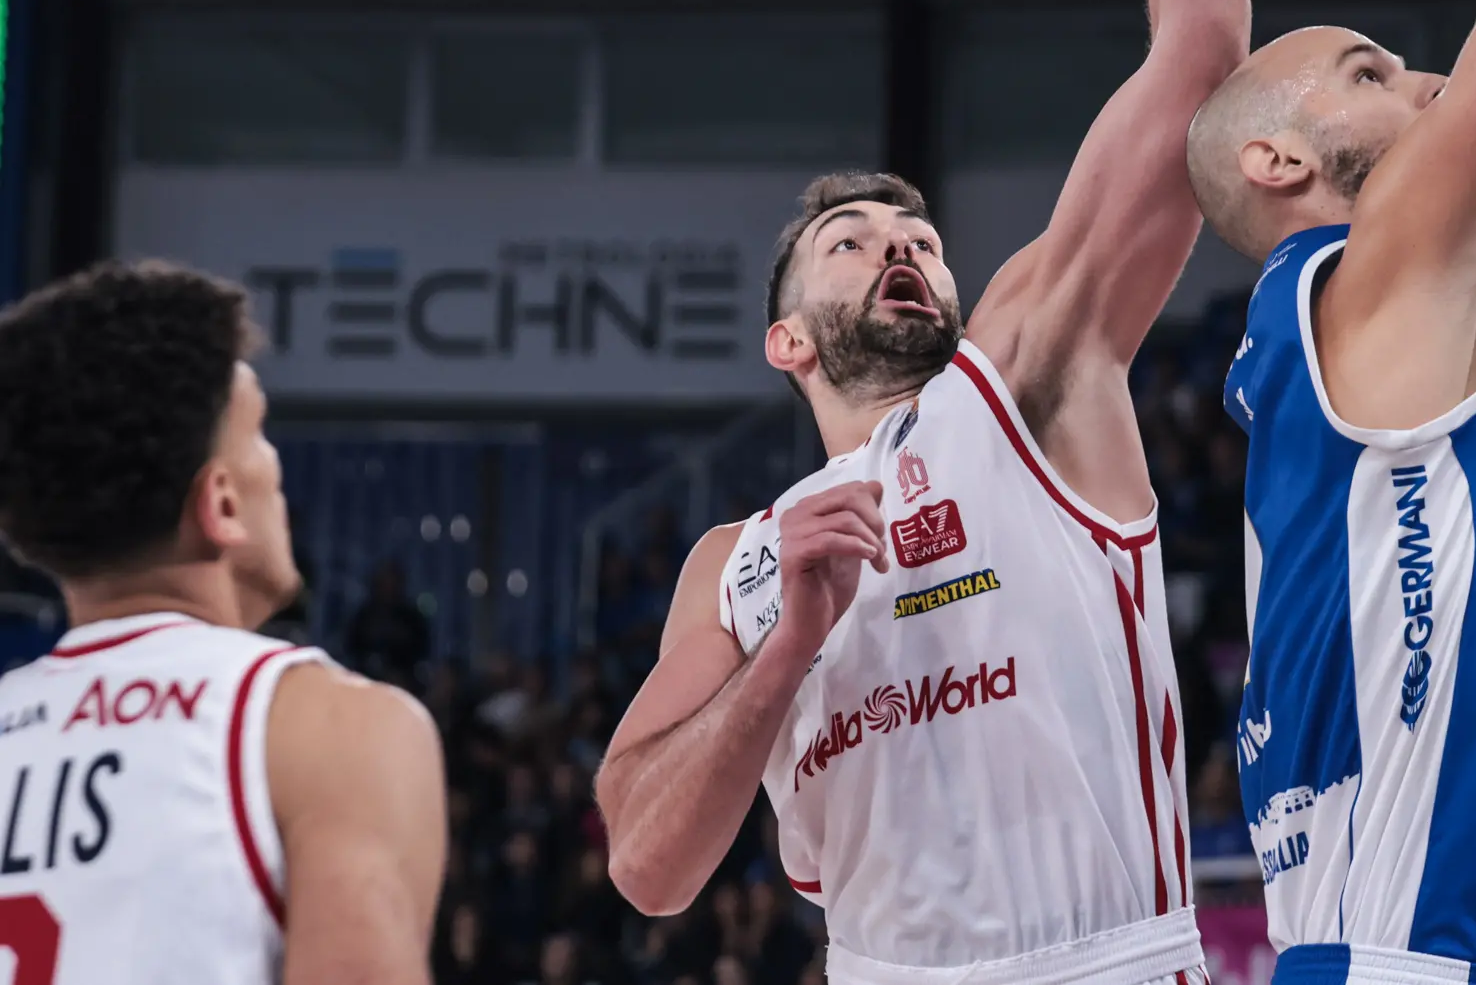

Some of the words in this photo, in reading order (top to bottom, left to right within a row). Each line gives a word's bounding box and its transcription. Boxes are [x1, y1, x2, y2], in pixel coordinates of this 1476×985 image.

[248, 265, 740, 359] TECHNE
[896, 504, 949, 545] EA7
[1391, 465, 1434, 650] GERMANI
[61, 677, 208, 732] AON
[905, 656, 1017, 725] World
